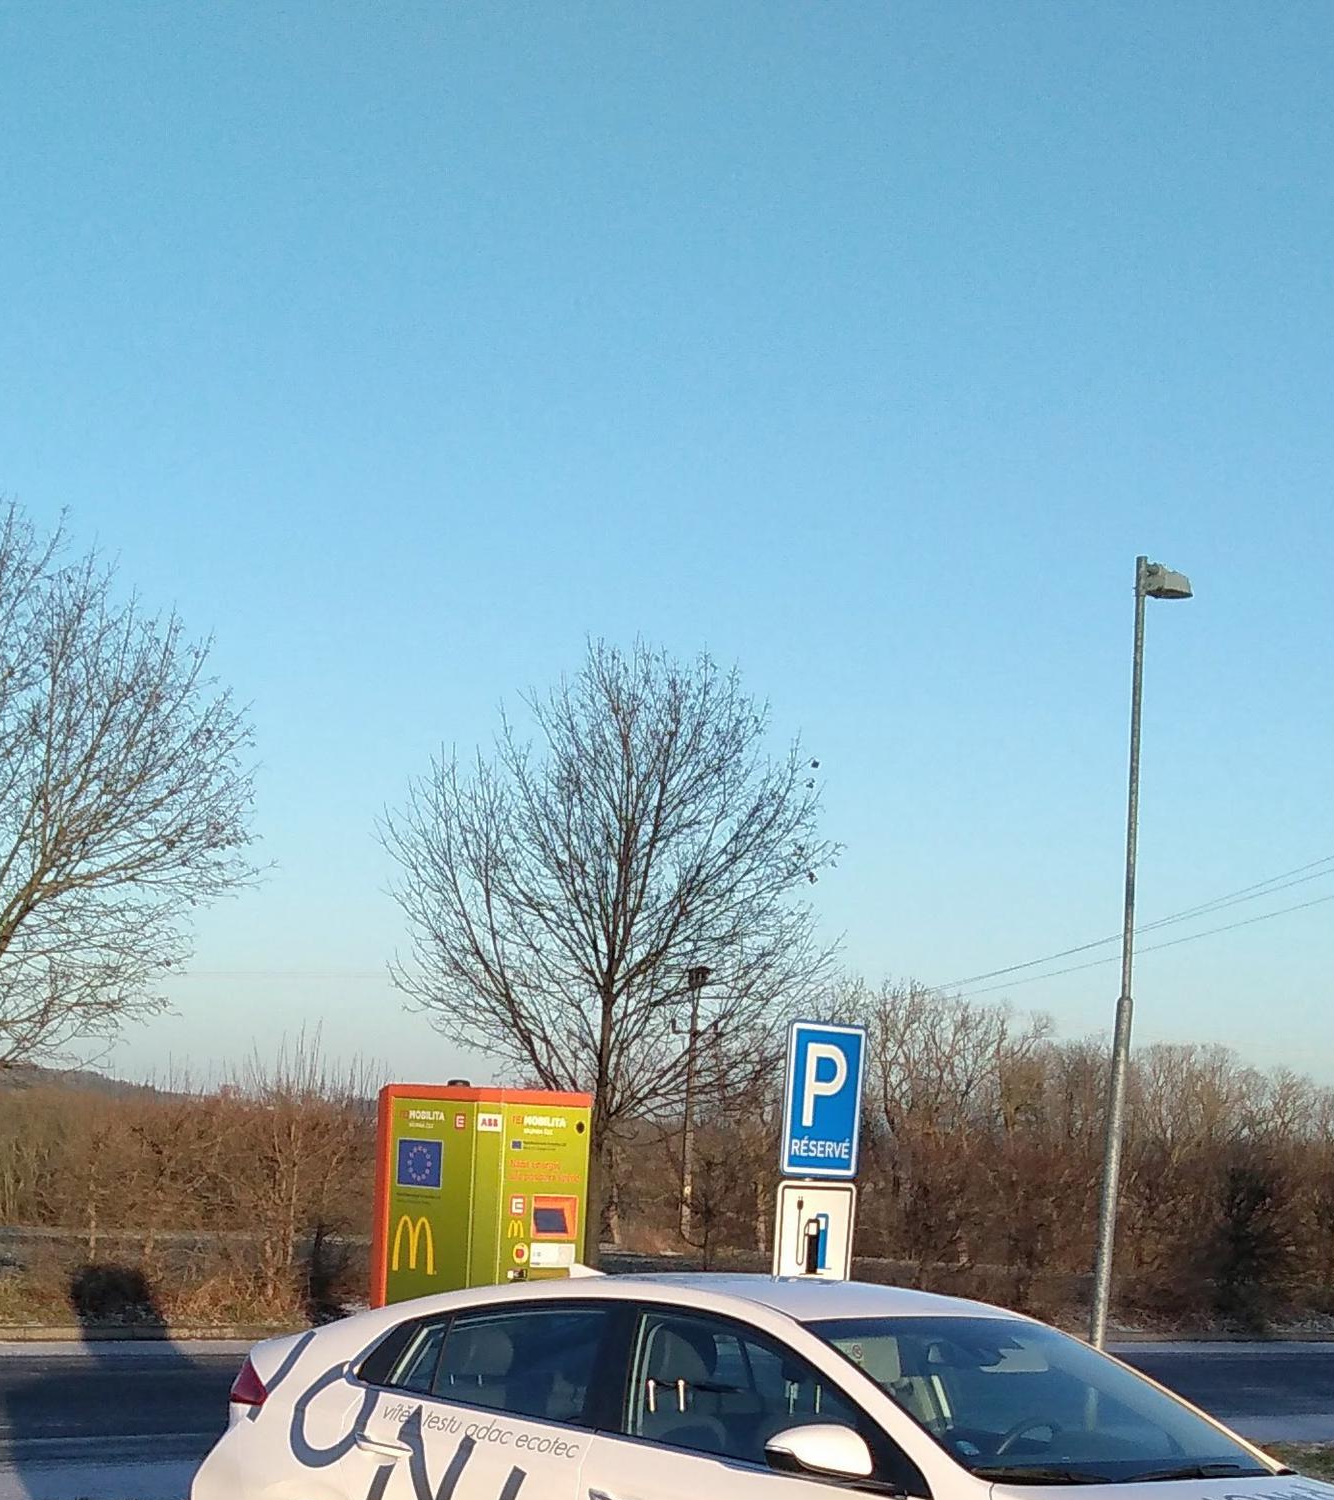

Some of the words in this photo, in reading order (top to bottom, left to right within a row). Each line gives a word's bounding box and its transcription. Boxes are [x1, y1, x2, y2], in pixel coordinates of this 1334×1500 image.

[802, 1042, 847, 1127] P
[480, 1118, 499, 1127] ABB
[790, 1136, 851, 1159] RÉSERVÉ
[383, 1403, 419, 1424] vítě
[423, 1411, 462, 1434] testu
[466, 1419, 513, 1446] adac
[515, 1433, 580, 1459] ecotec
